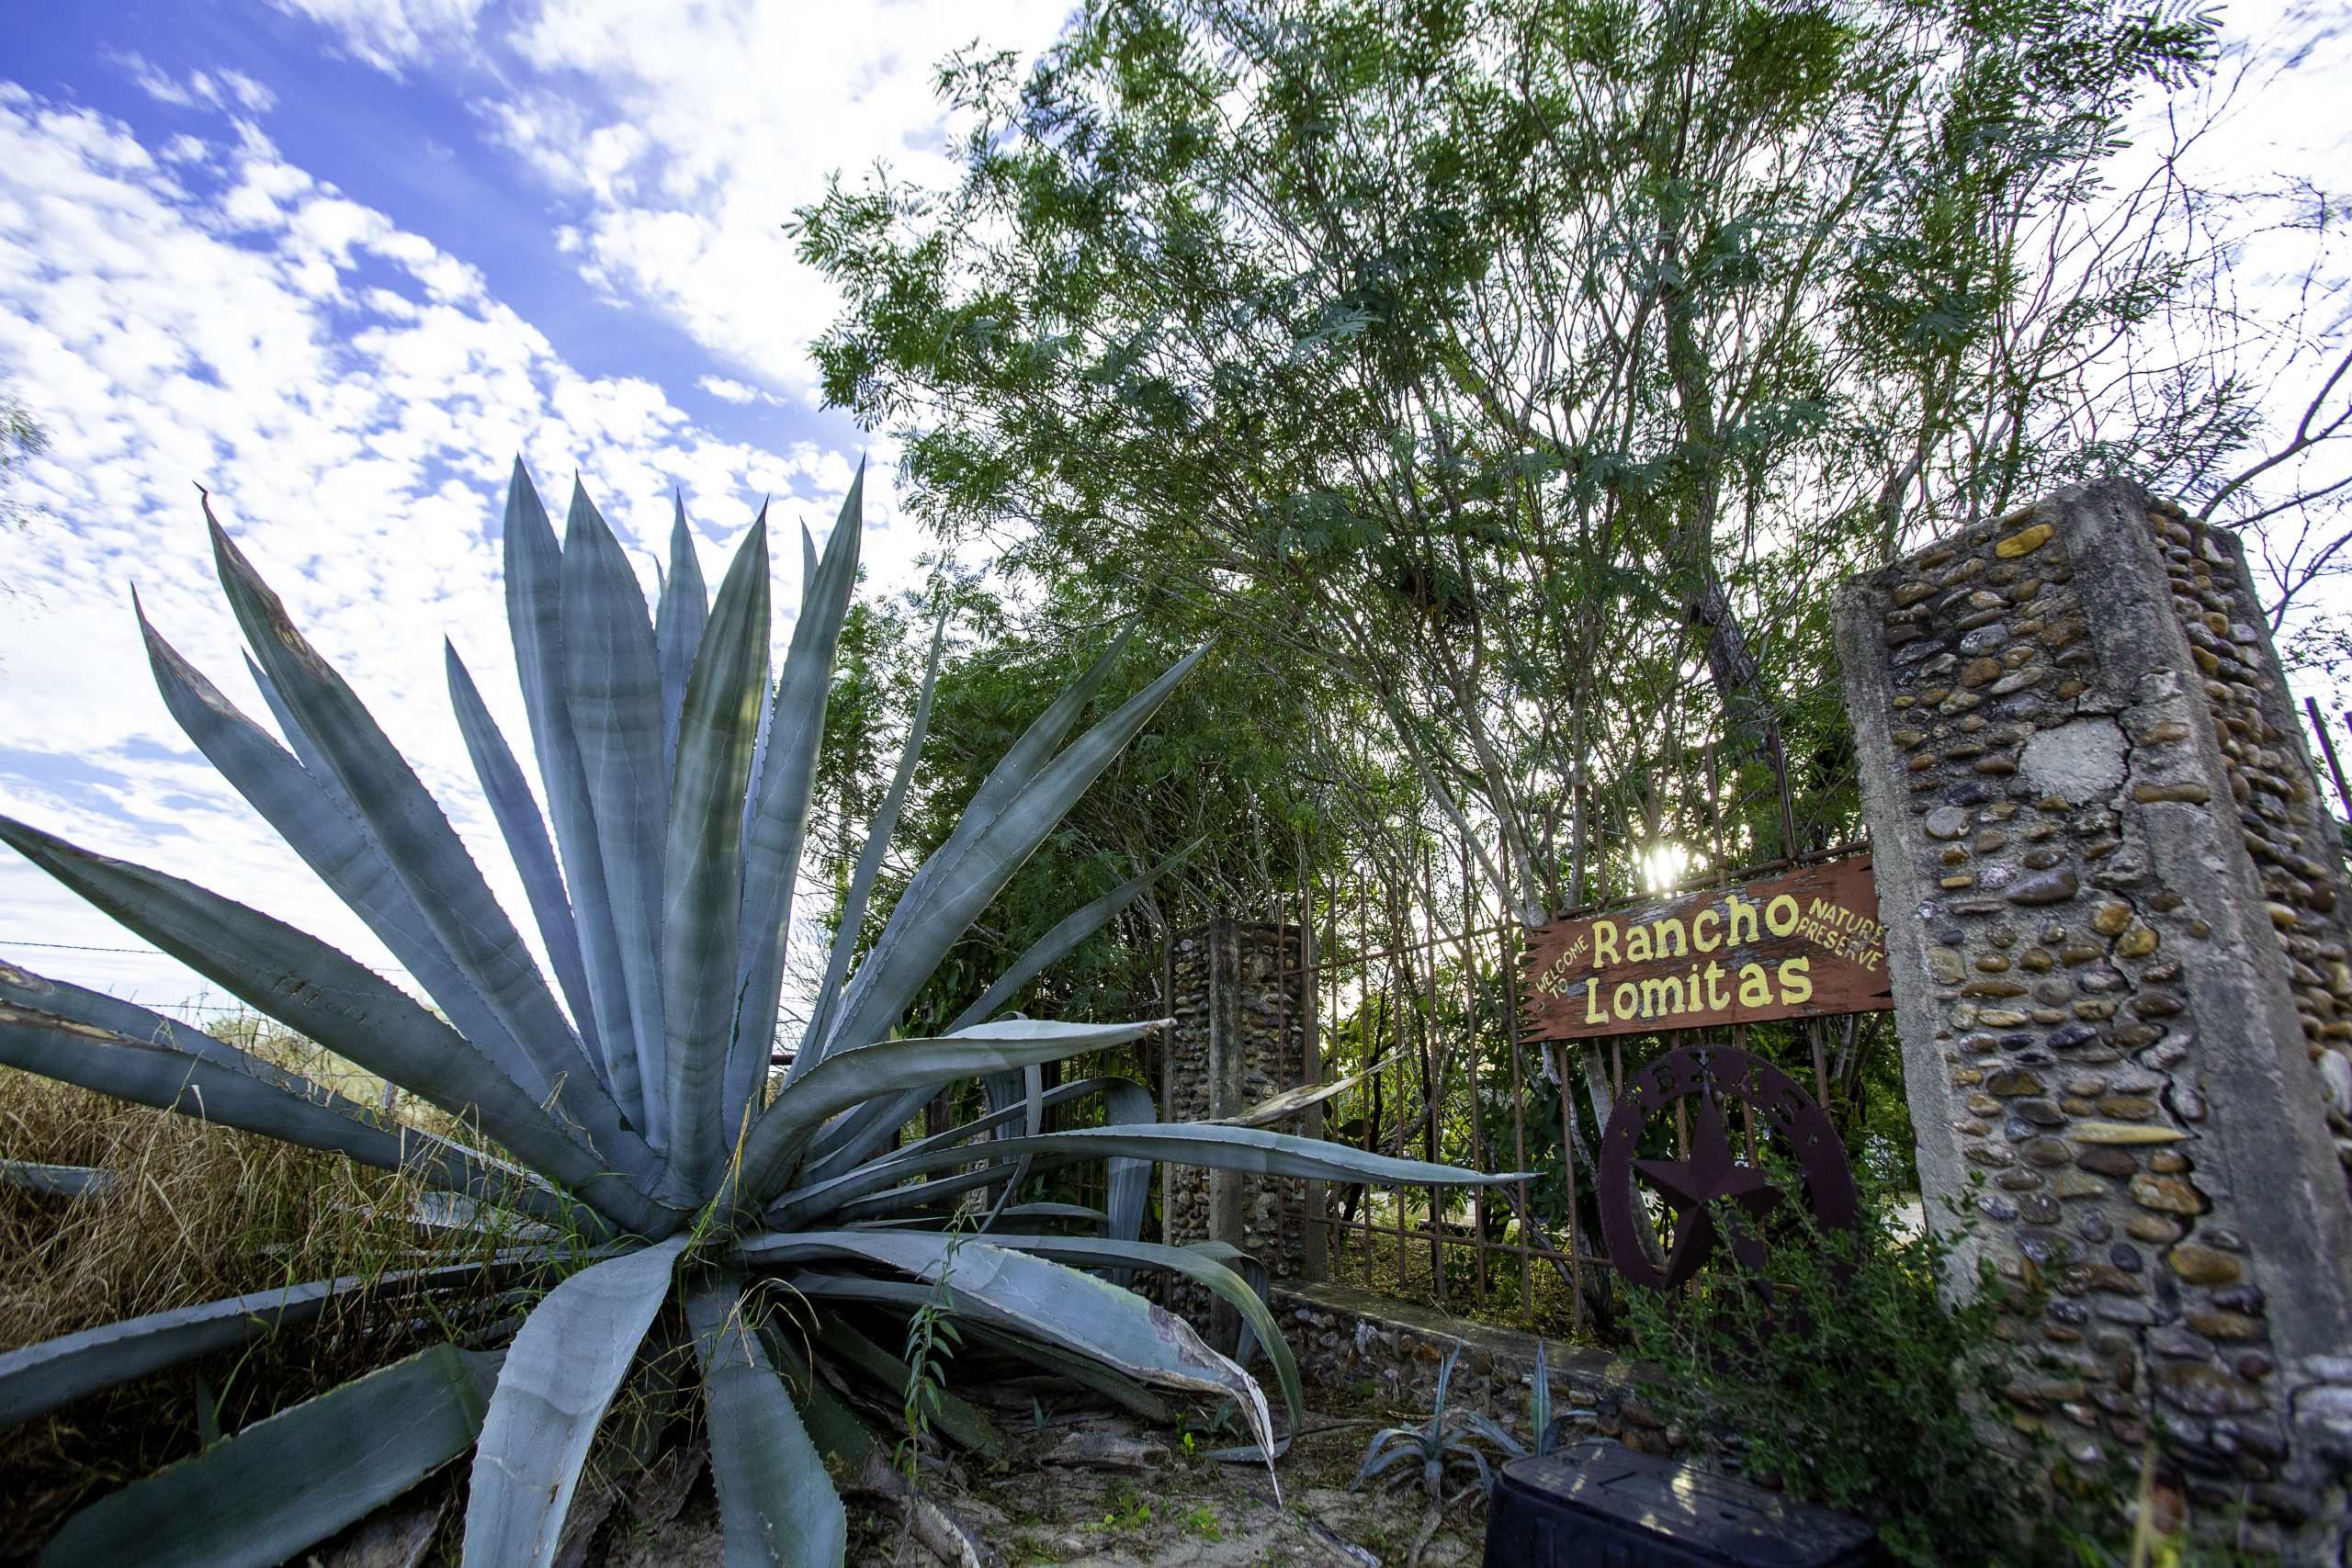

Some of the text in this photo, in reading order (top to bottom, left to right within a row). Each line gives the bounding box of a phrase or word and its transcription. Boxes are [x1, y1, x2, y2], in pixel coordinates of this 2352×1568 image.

[1591, 894, 1800, 969] Rancho
[1795, 917, 1884, 972] PRESERVE
[1808, 897, 1884, 947] NATURE
[1535, 934, 1589, 994] WELCOME
[1548, 977, 1568, 1000] TO
[1585, 955, 1814, 1025] Lomitas
[1624, 1051, 1806, 1125] TEXAS
